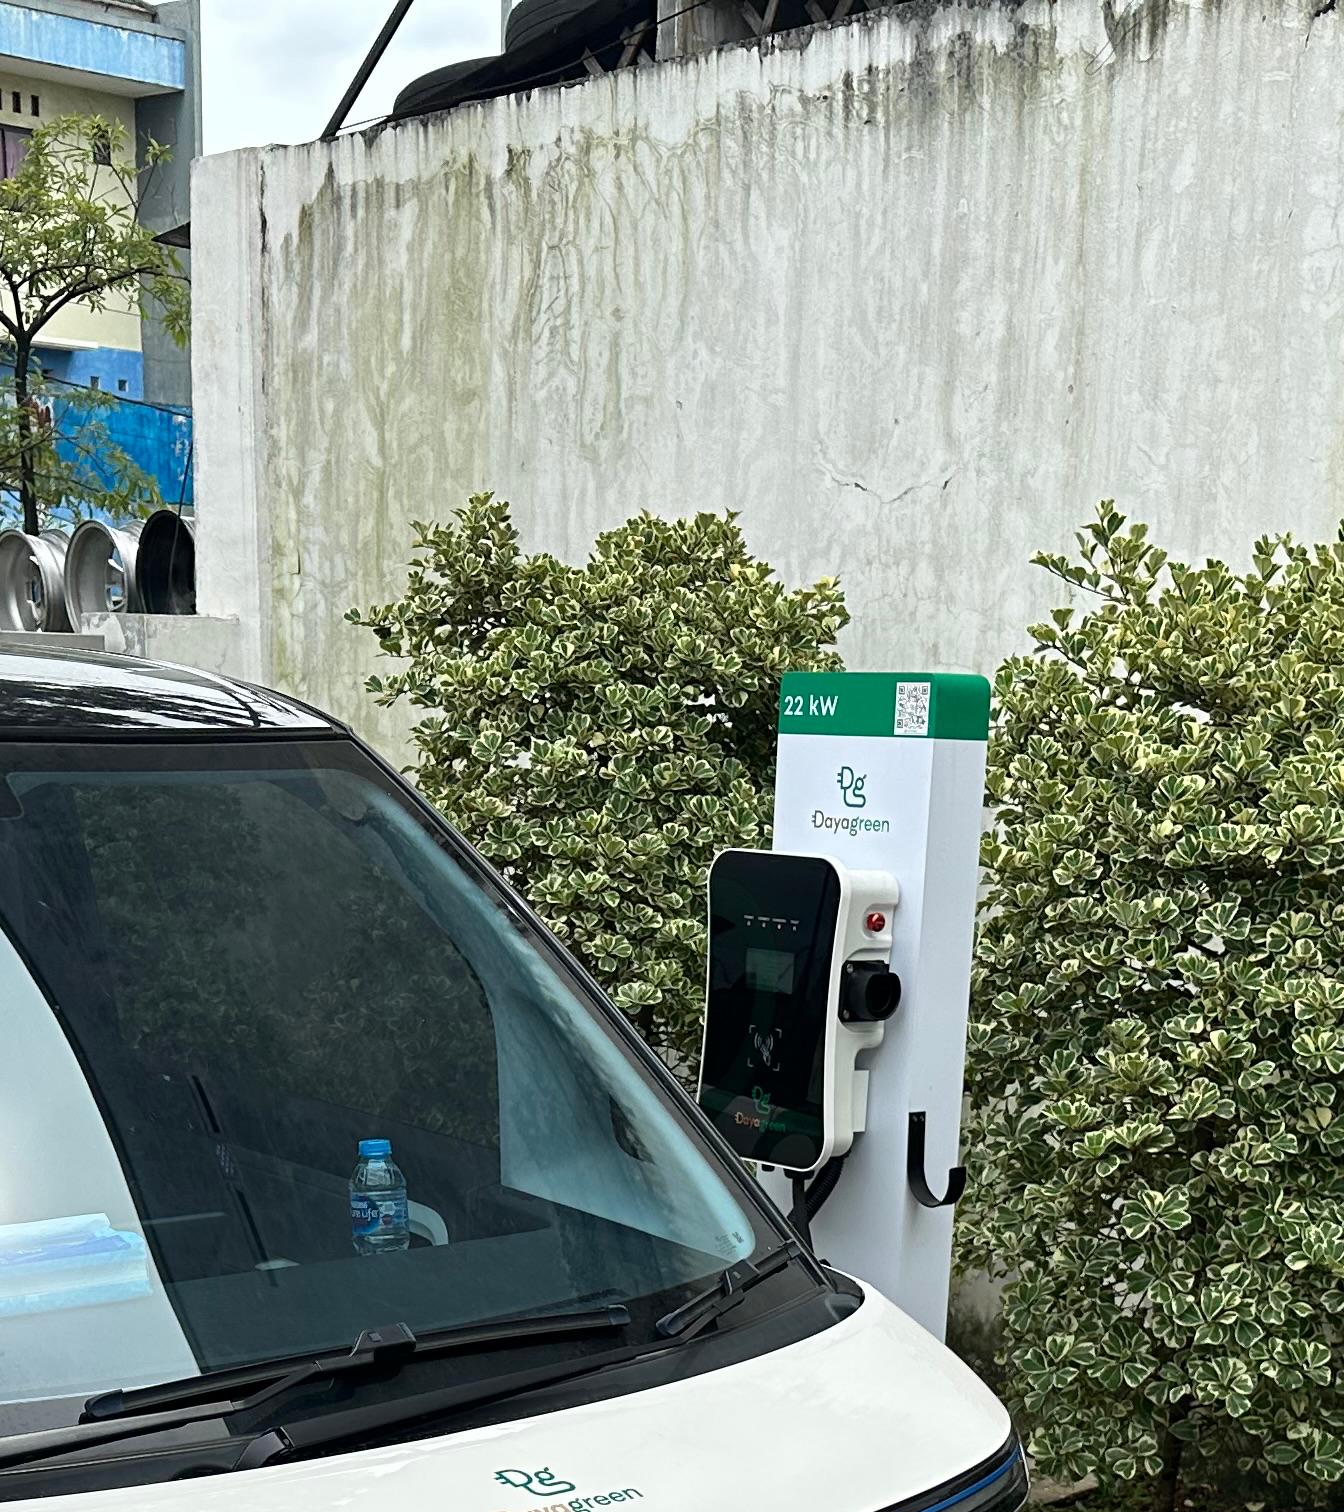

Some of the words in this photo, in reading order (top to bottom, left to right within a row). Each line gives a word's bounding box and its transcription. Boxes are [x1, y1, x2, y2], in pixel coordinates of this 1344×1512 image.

[783, 695, 804, 716] 22
[809, 694, 839, 717] kW
[811, 809, 890, 837] Dayagreen
